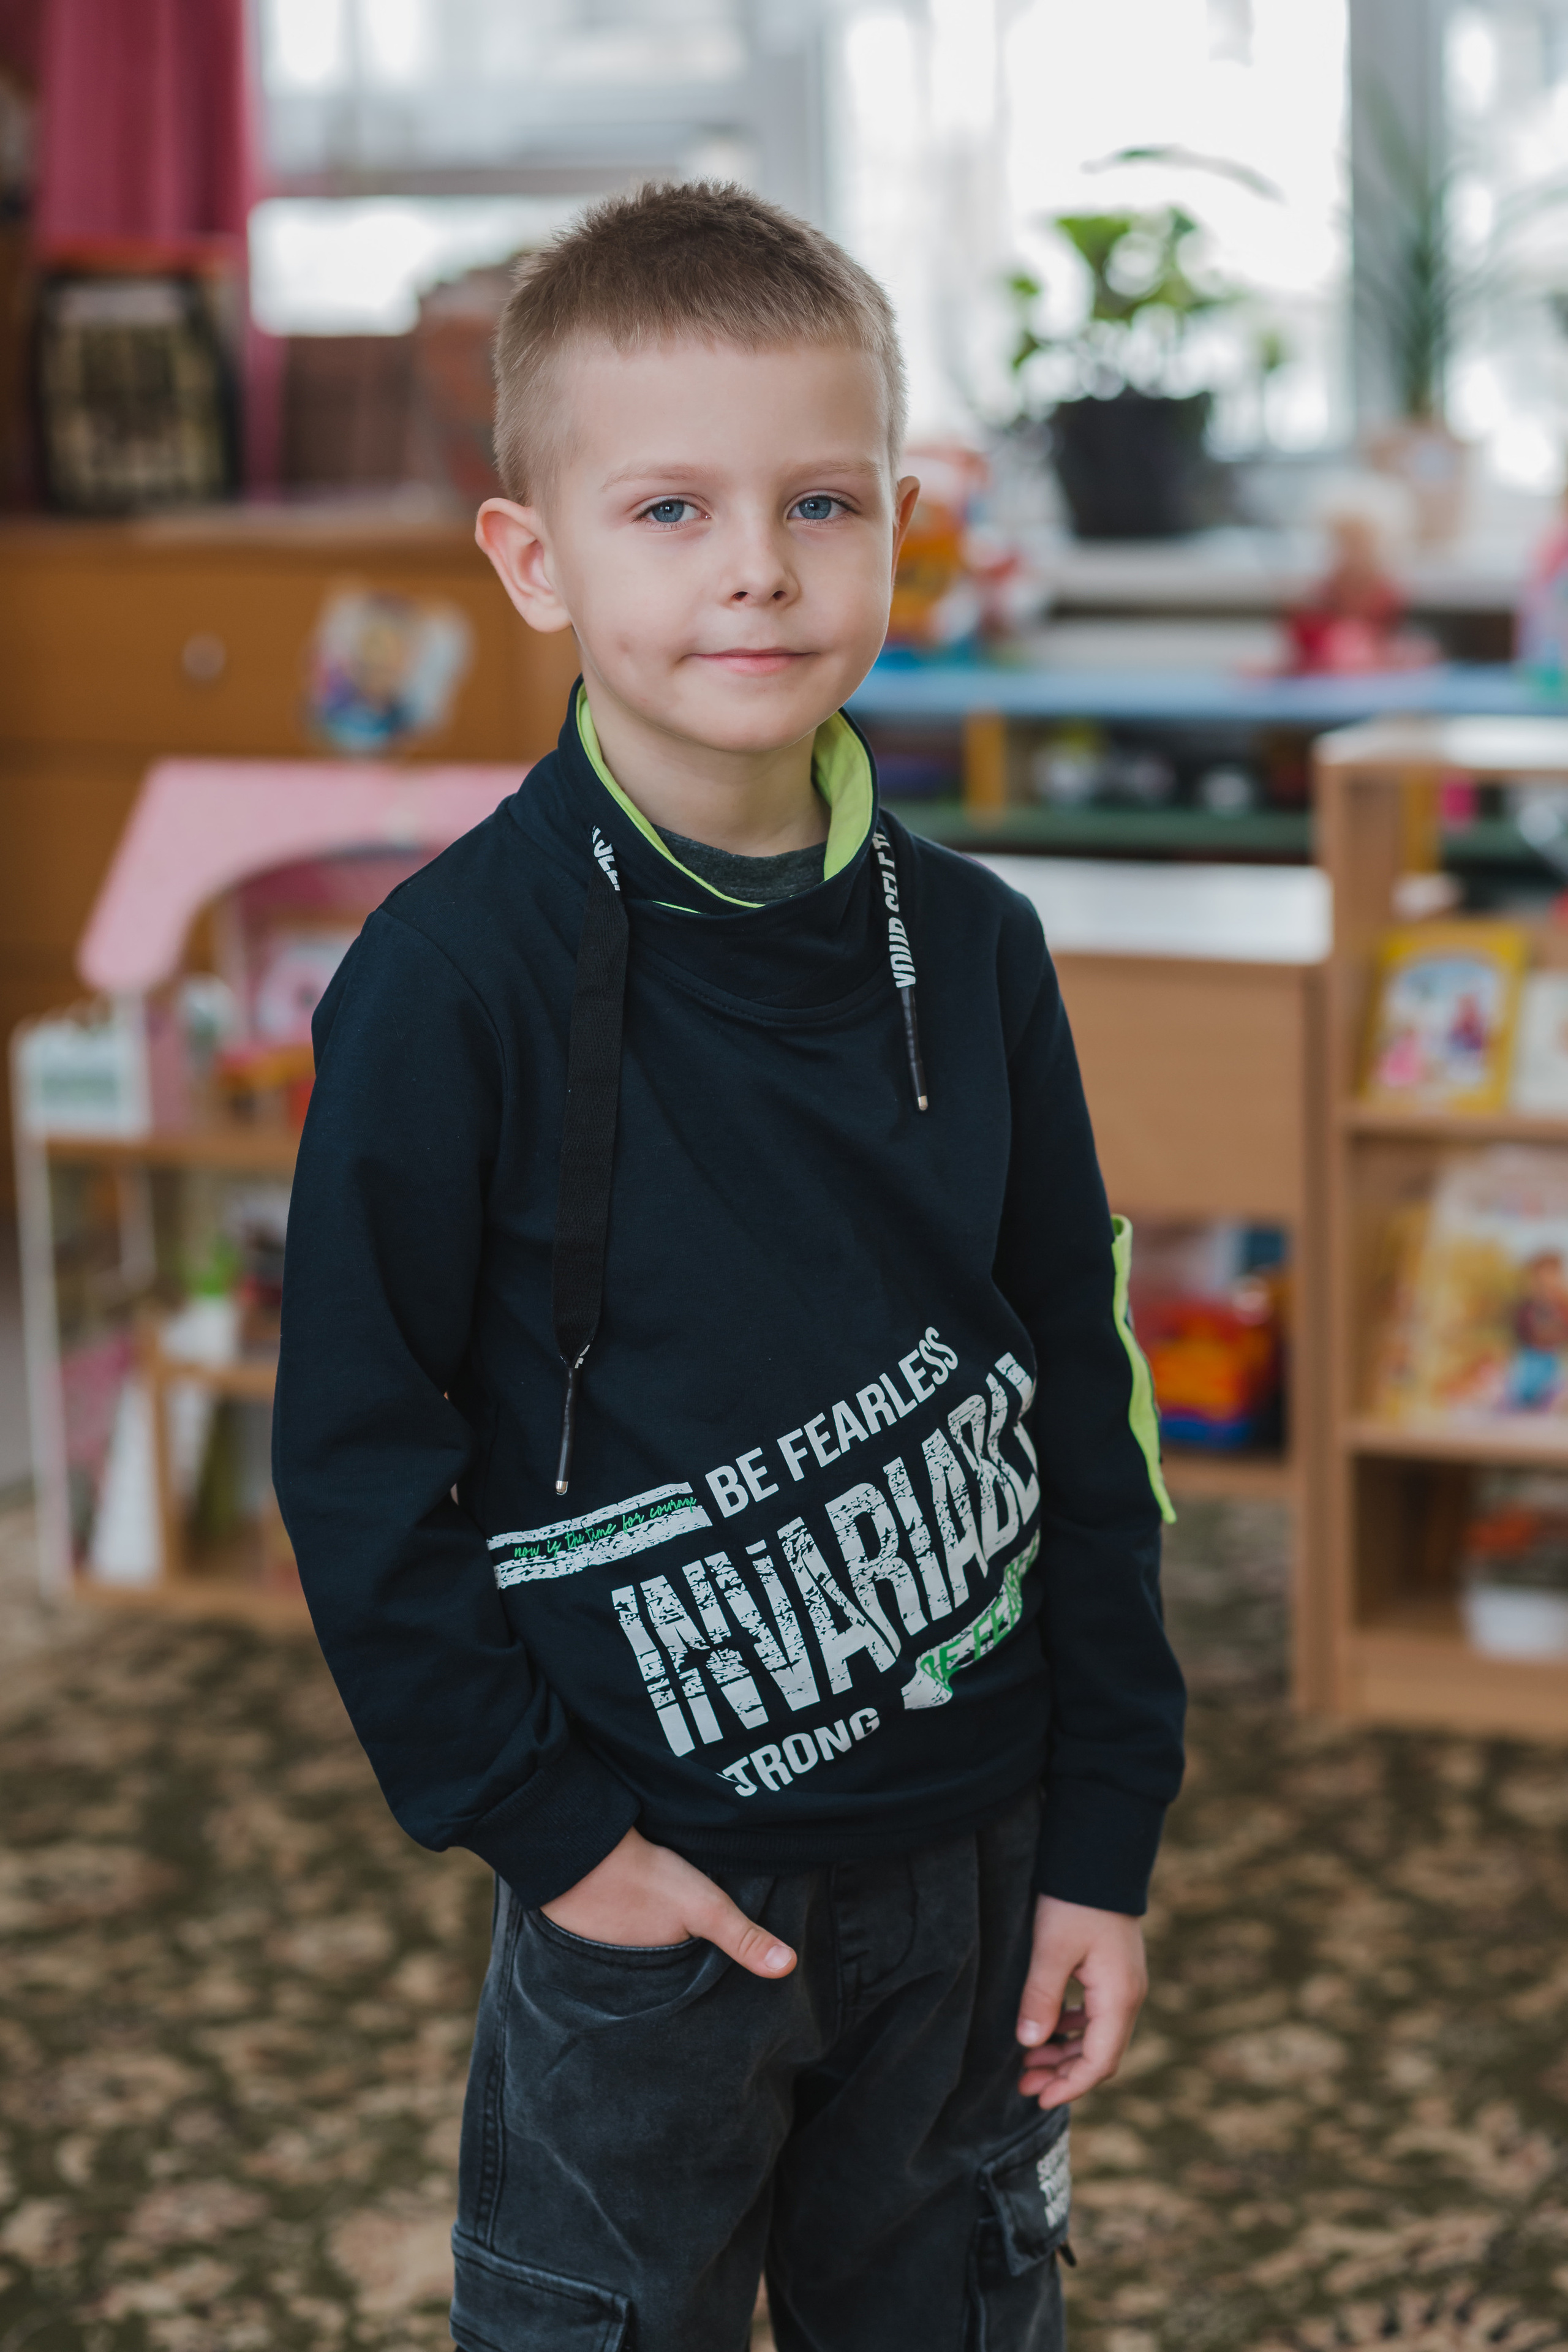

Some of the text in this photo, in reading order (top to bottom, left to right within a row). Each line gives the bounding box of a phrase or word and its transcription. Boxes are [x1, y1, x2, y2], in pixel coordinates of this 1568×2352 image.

[705, 1326, 959, 1518] BE FEARLESS
[514, 1496, 697, 1558] now is the time for courage
